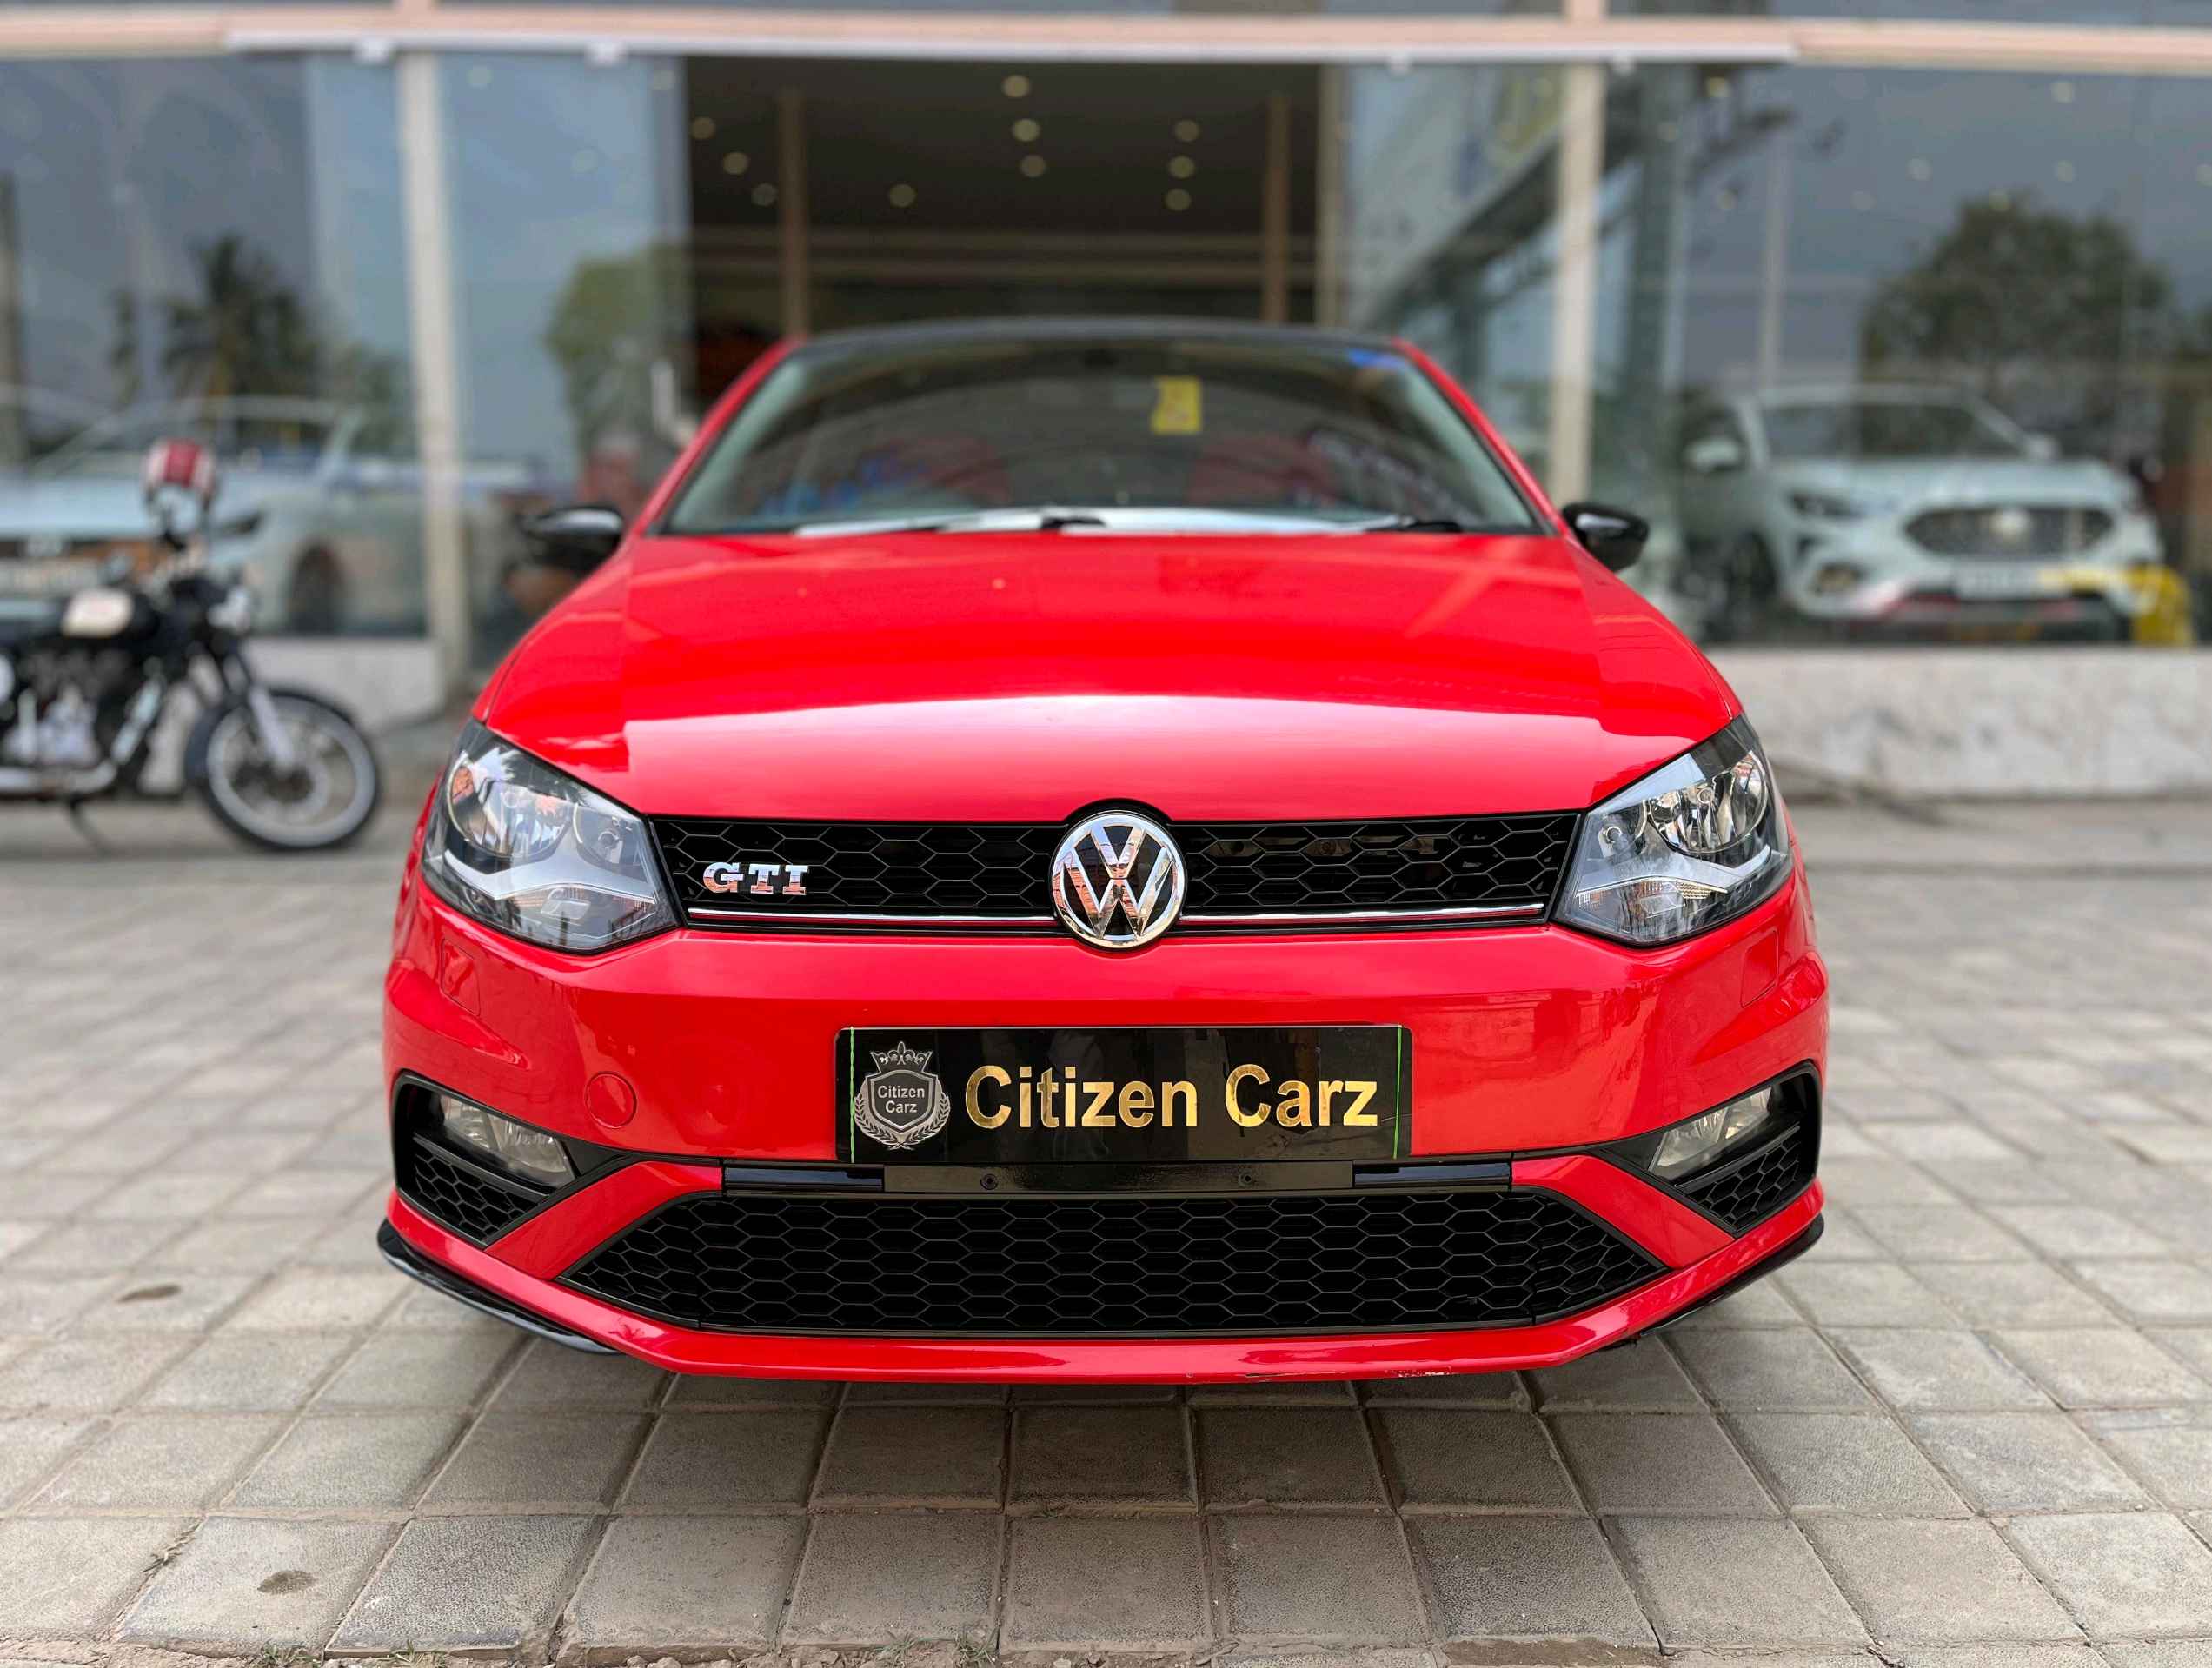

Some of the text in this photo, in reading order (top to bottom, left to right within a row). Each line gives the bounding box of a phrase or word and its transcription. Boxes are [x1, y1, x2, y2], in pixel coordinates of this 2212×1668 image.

[703, 862, 808, 895] GTI
[877, 1085, 925, 1098] Citizen
[965, 1064, 1378, 1128] Citizen Carz
[885, 1100, 918, 1113] Carz
